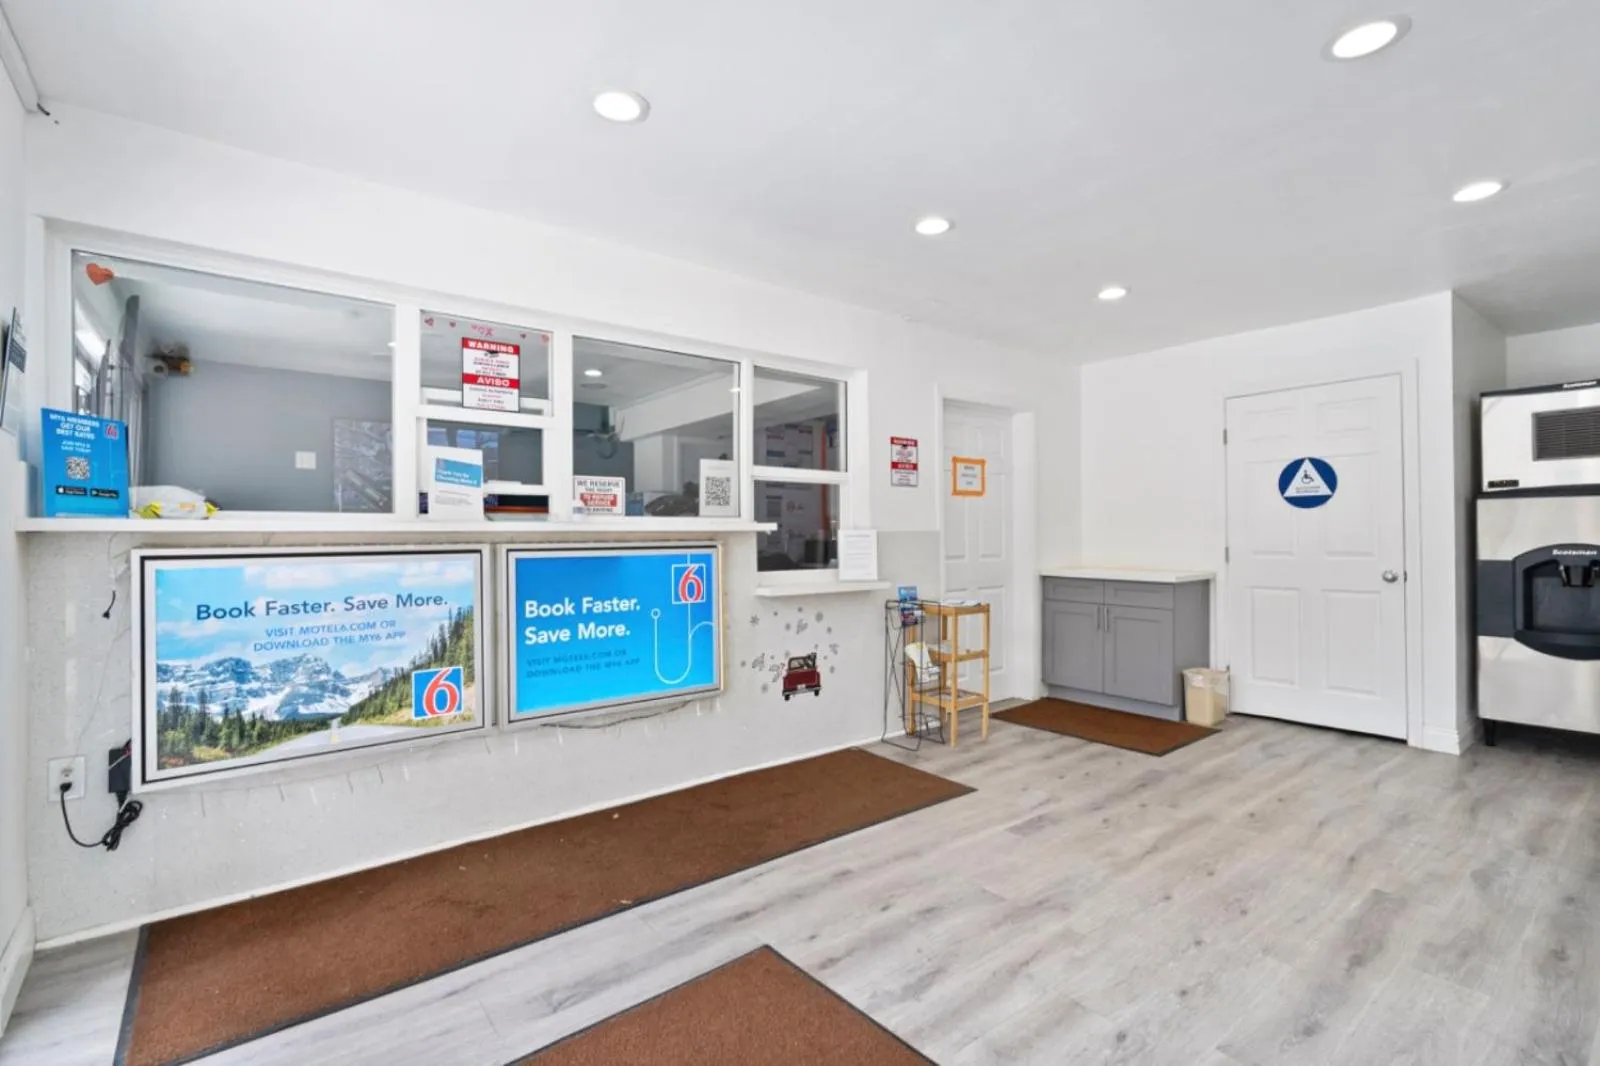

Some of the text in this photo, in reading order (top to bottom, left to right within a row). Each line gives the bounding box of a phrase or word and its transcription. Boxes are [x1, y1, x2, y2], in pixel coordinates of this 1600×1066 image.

[468, 340, 514, 352] WARNING
[477, 376, 510, 386] AVISO
[678, 565, 703, 603] 6
[196, 592, 449, 620] Book Faster. Save More.
[525, 596, 641, 618] Book Faster.
[265, 627, 294, 637] VISIT
[380, 620, 396, 629] OR
[524, 621, 631, 645] Save More.
[253, 630, 406, 652] DOWNLOAD THE MY6 APP
[423, 667, 459, 717] 6
